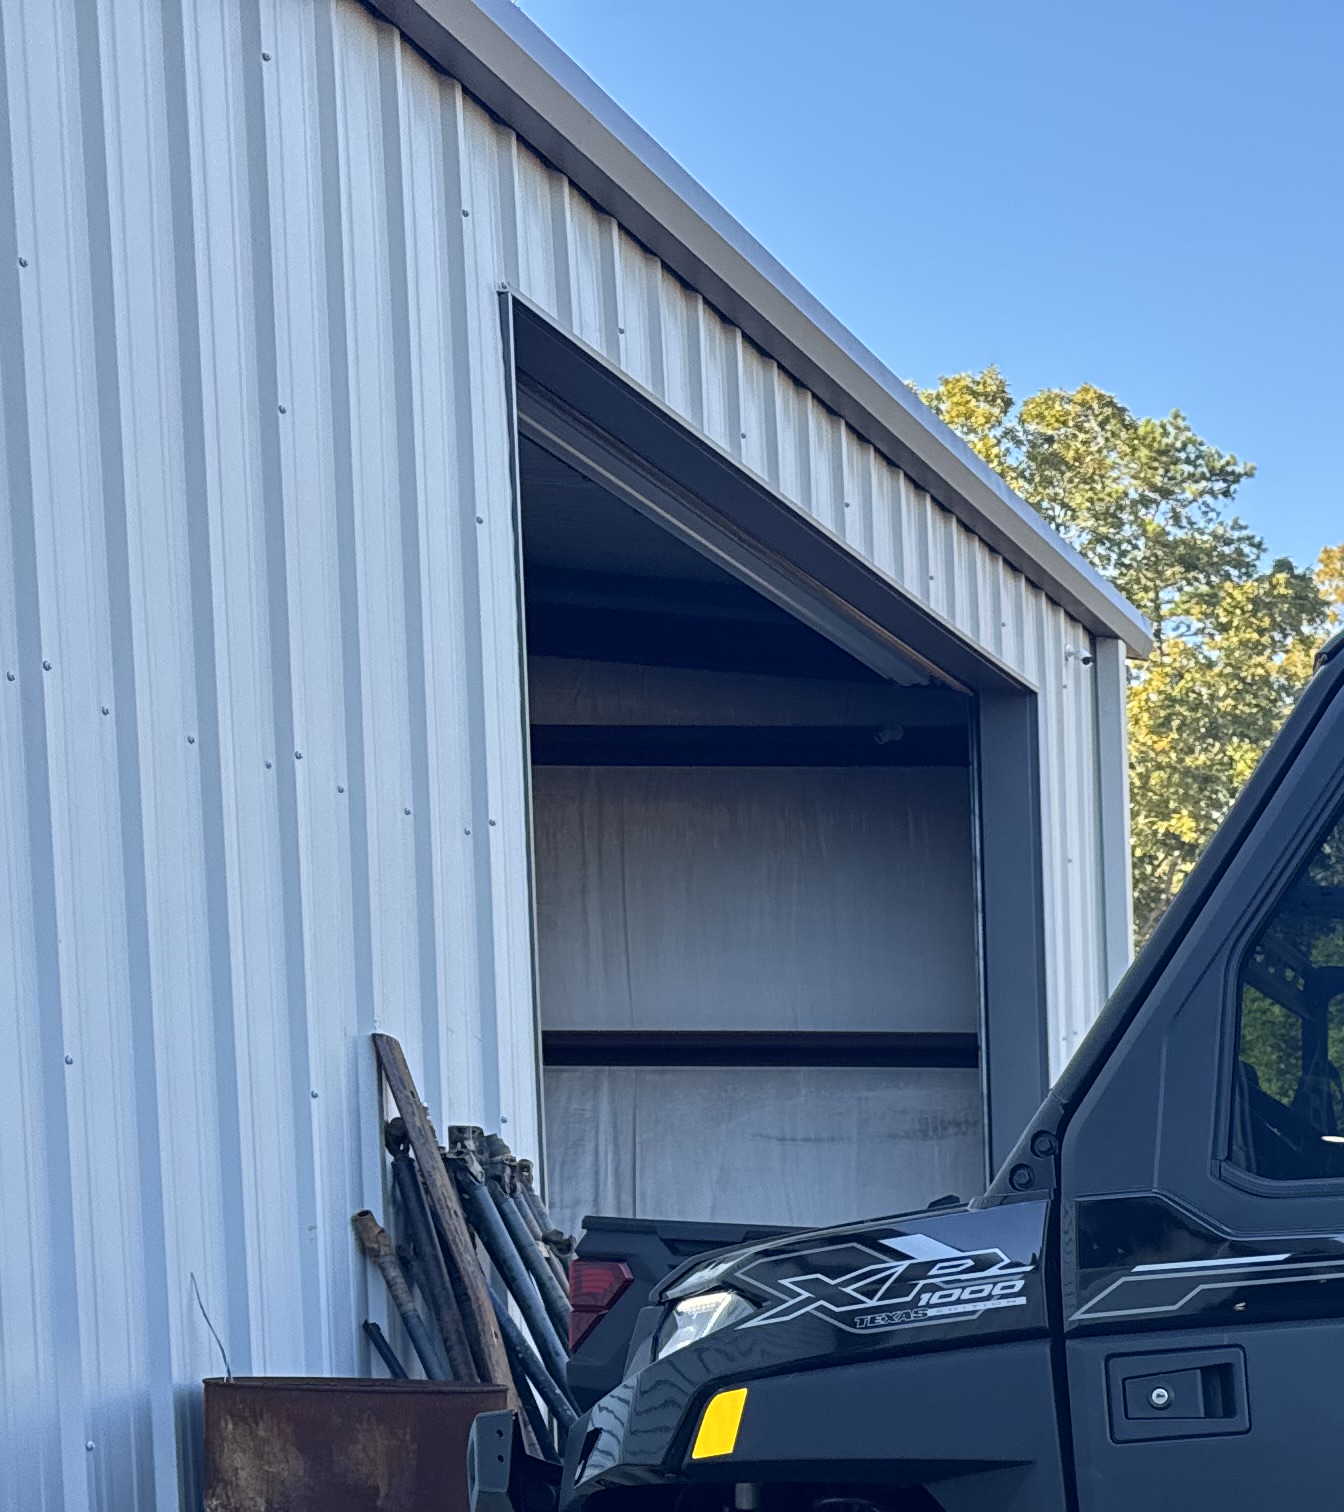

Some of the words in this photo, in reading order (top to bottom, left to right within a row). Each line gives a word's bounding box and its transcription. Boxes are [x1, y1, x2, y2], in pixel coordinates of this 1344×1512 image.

[735, 1248, 1034, 1329] XP
[917, 1279, 1025, 1307] 1000
[855, 1308, 930, 1328] TEXAS
[936, 1299, 1018, 1314] EDITION
